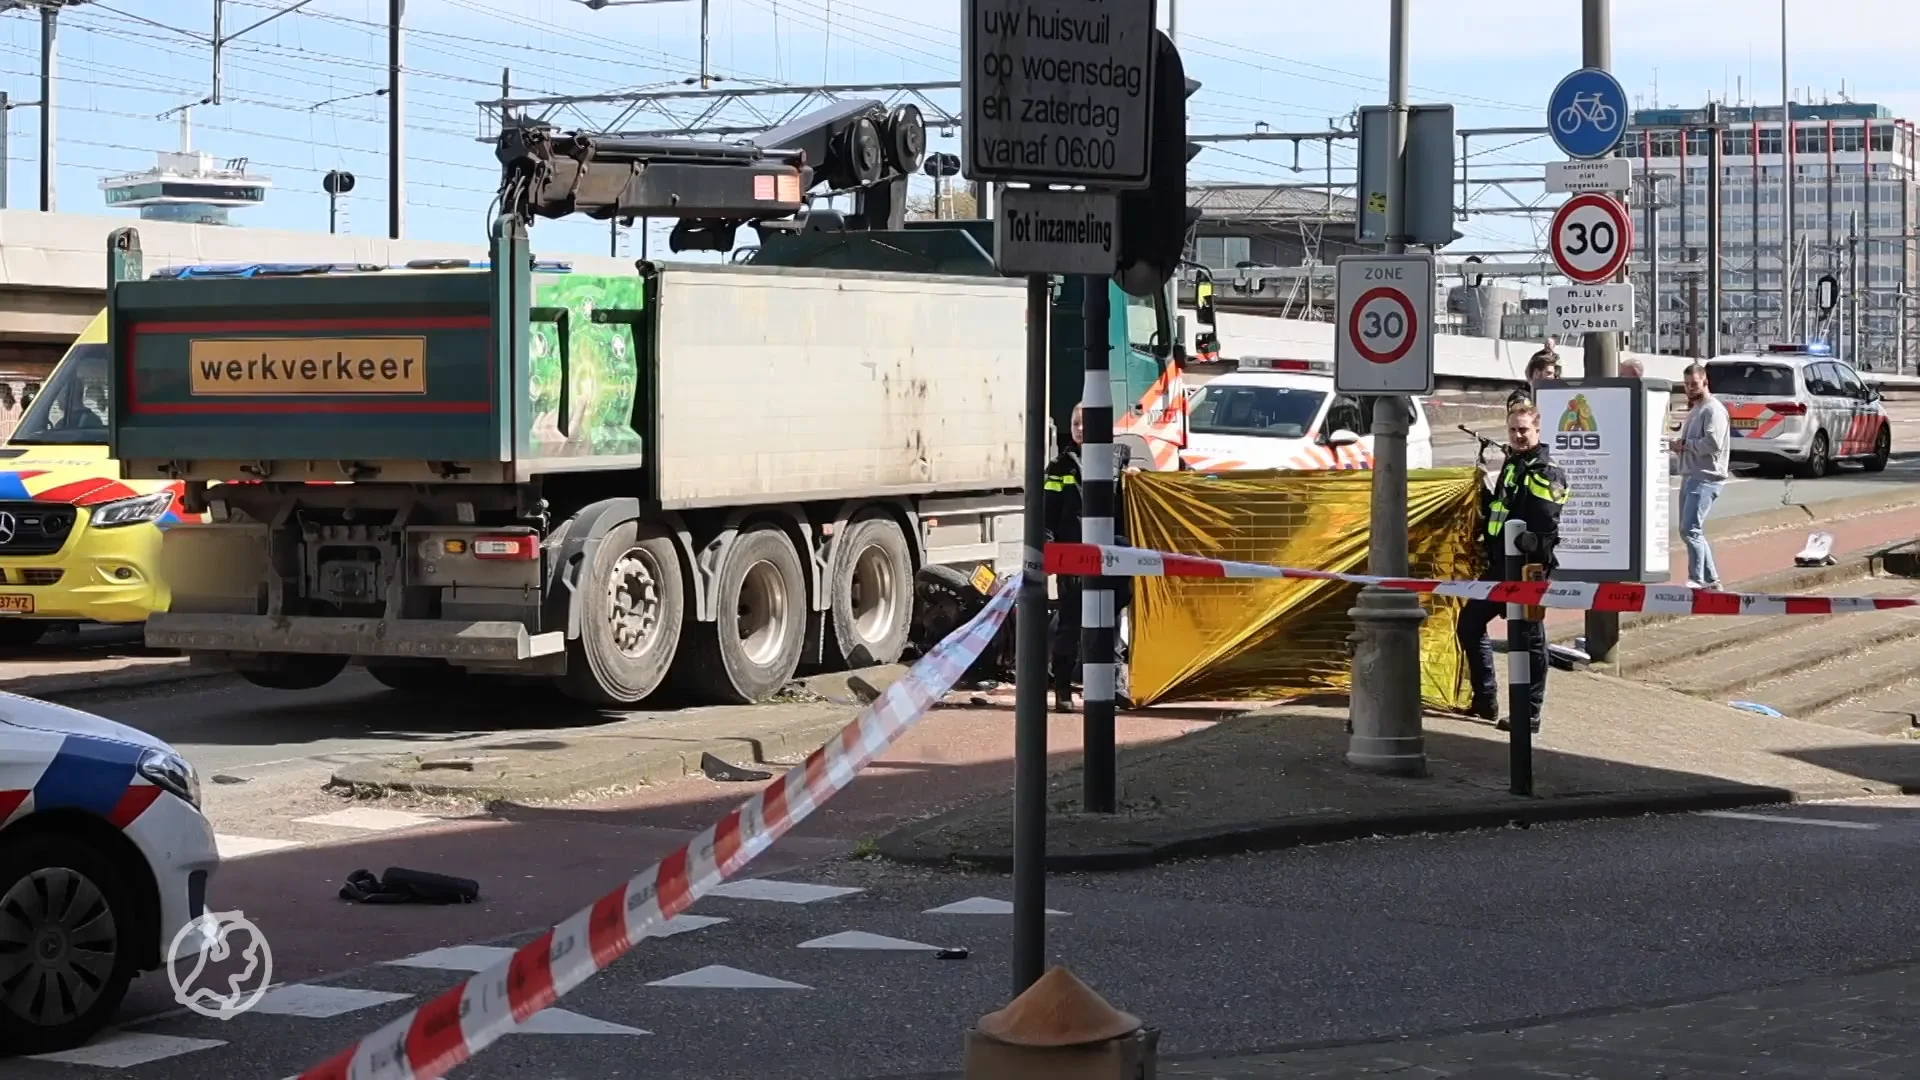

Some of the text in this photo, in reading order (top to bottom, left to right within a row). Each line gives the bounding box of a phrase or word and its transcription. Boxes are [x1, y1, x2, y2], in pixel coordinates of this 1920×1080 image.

[983, 6, 1109, 45] uw huisvuil
[983, 52, 1141, 97] op woensdag
[983, 95, 1120, 137] en zaterdag
[983, 134, 1048, 165] vanaf
[1008, 209, 1112, 252] Tot inzameling
[1565, 222, 1614, 255] 30
[1364, 267, 1403, 280] ZONE
[1567, 288, 1607, 298] m.u.v.
[1556, 301, 1624, 317] gebruikers
[1562, 318, 1617, 329] OV-baan
[1362, 311, 1403, 339] 30
[200, 351, 415, 381] werkverkeer
[1556, 433, 1600, 450] 909
